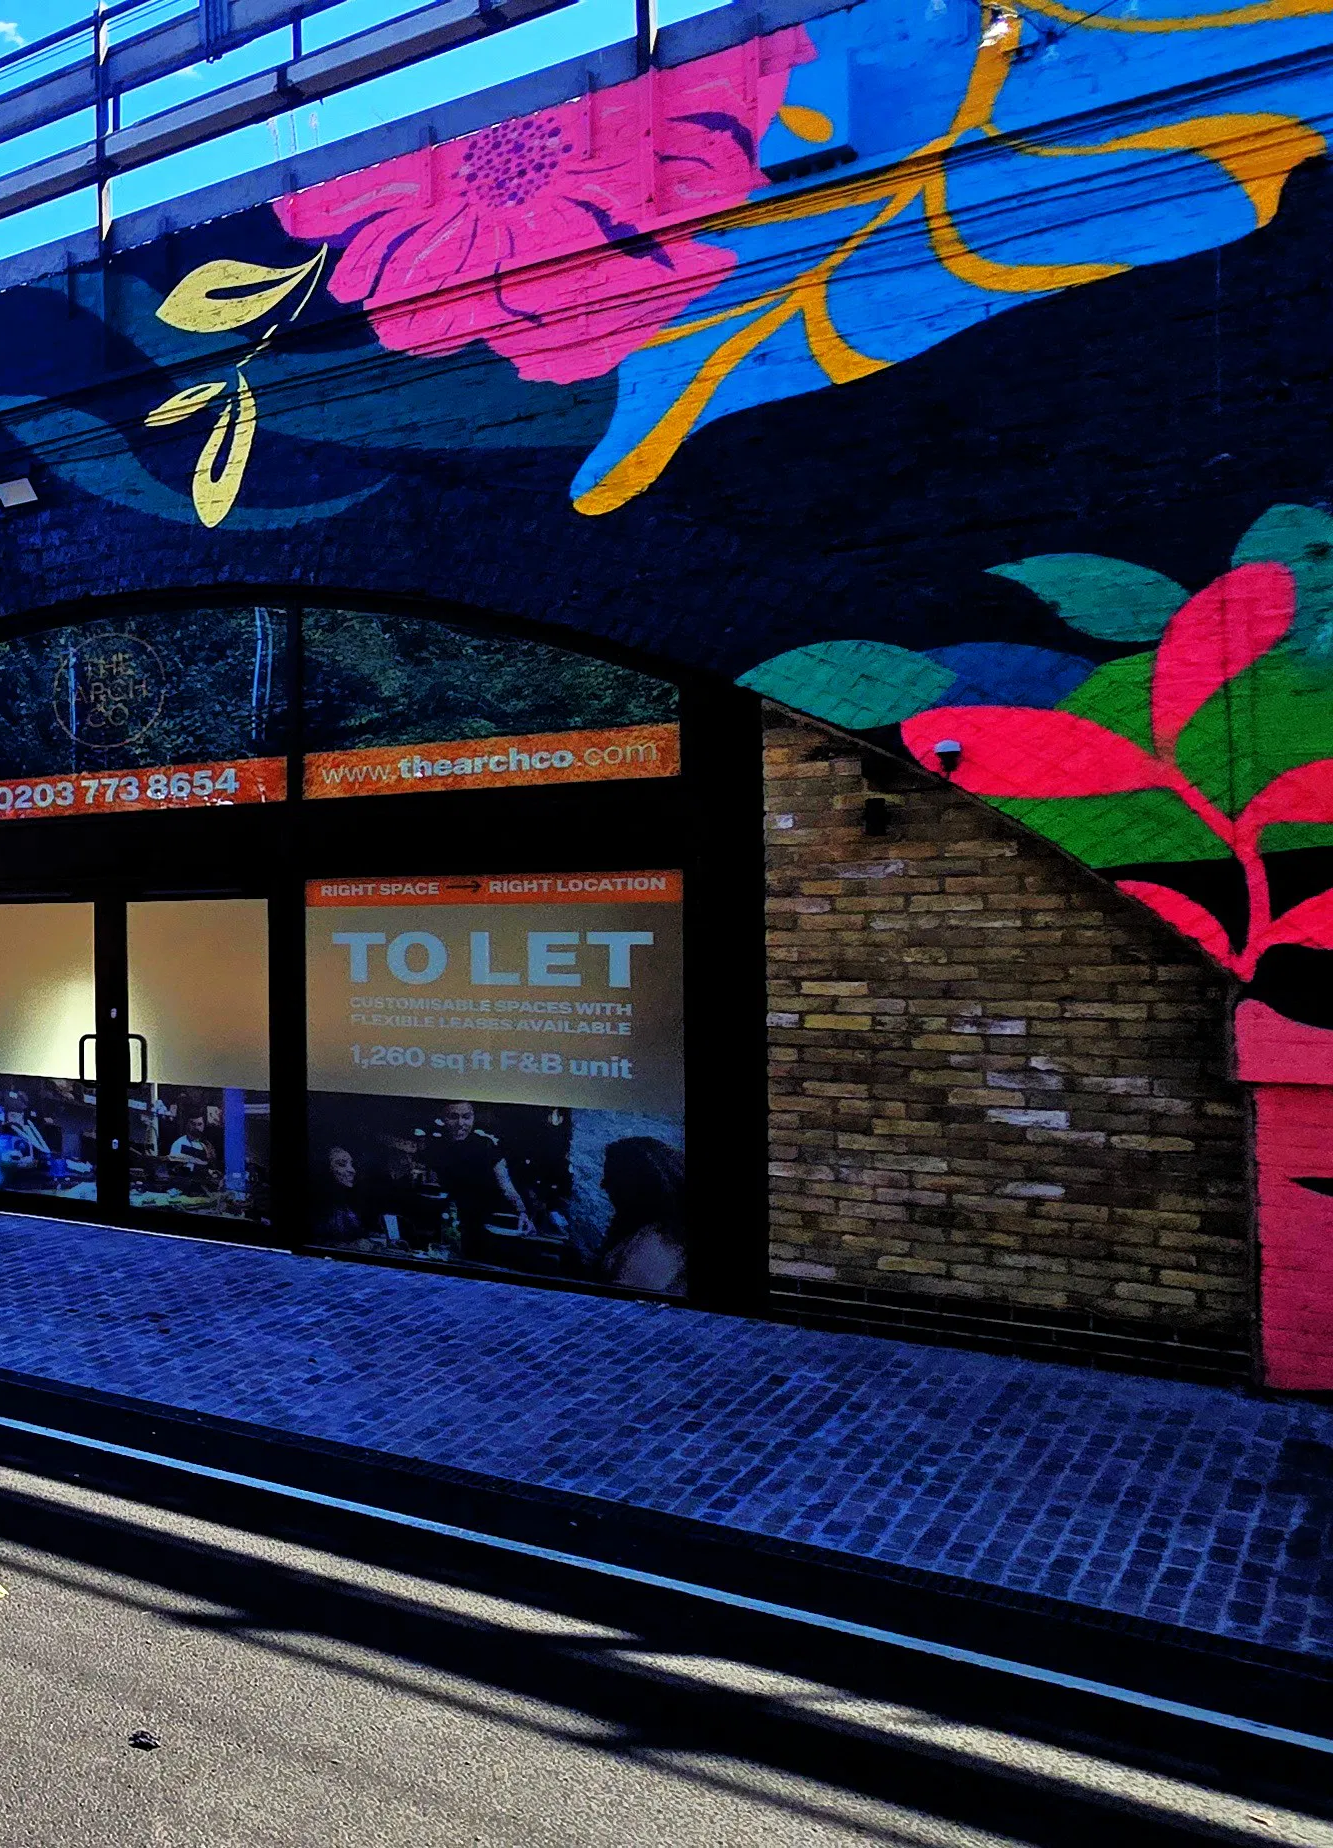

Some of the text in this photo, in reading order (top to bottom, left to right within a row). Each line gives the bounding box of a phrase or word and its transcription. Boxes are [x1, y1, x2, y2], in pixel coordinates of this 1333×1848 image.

[321, 740, 658, 785] www.thearchco.com
[81, 776, 139, 804] 773
[146, 767, 240, 801] 8654
[320, 876, 667, 898] RIGHT SPACE RIGHT LOCATION
[332, 931, 654, 989] TO LET
[350, 996, 632, 1016] CUSTOMISABLE SPACES WITH
[351, 1013, 632, 1036] FLEXIBLE LEASES AVAILABLE
[350, 1044, 633, 1080] 1,260 sq ft F&B unit
